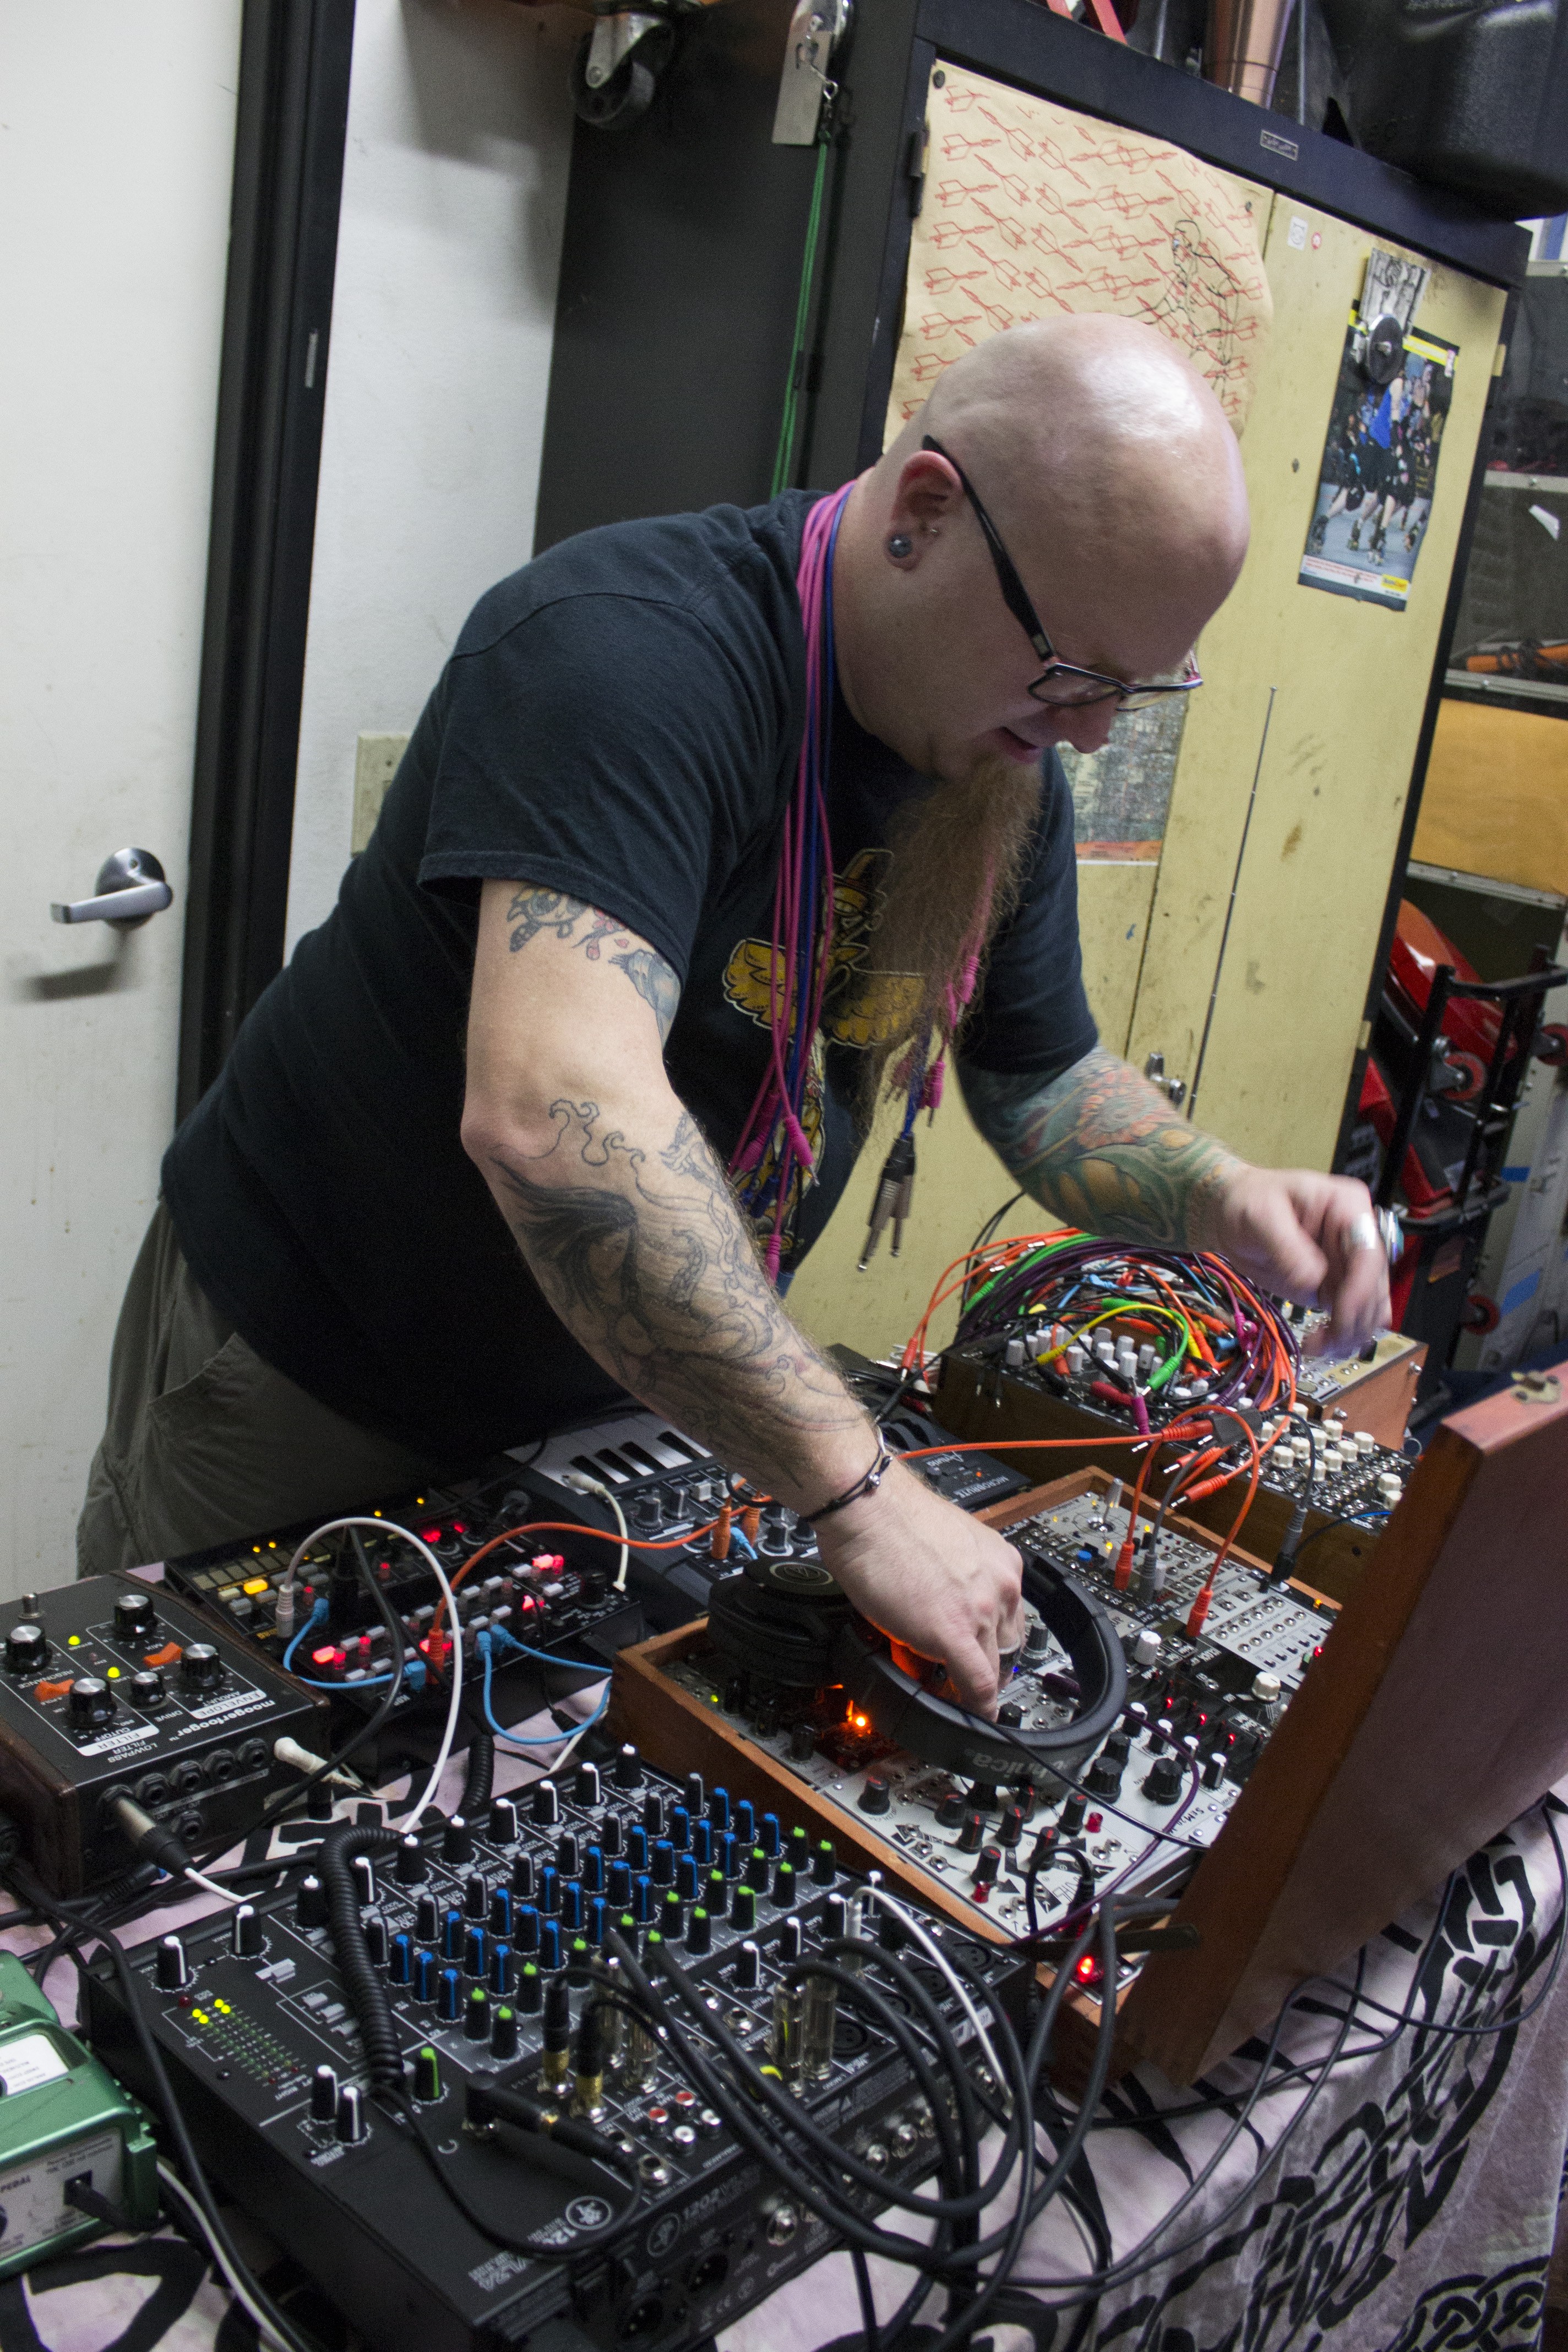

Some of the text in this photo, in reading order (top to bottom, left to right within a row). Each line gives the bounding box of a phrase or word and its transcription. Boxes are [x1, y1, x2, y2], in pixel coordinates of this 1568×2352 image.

[199, 1692, 262, 1717] ENVELOPE
[154, 1709, 184, 1723] DRIVE
[97, 1732, 141, 1750] FILTER
[107, 1741, 159, 1763] LOWPASS
